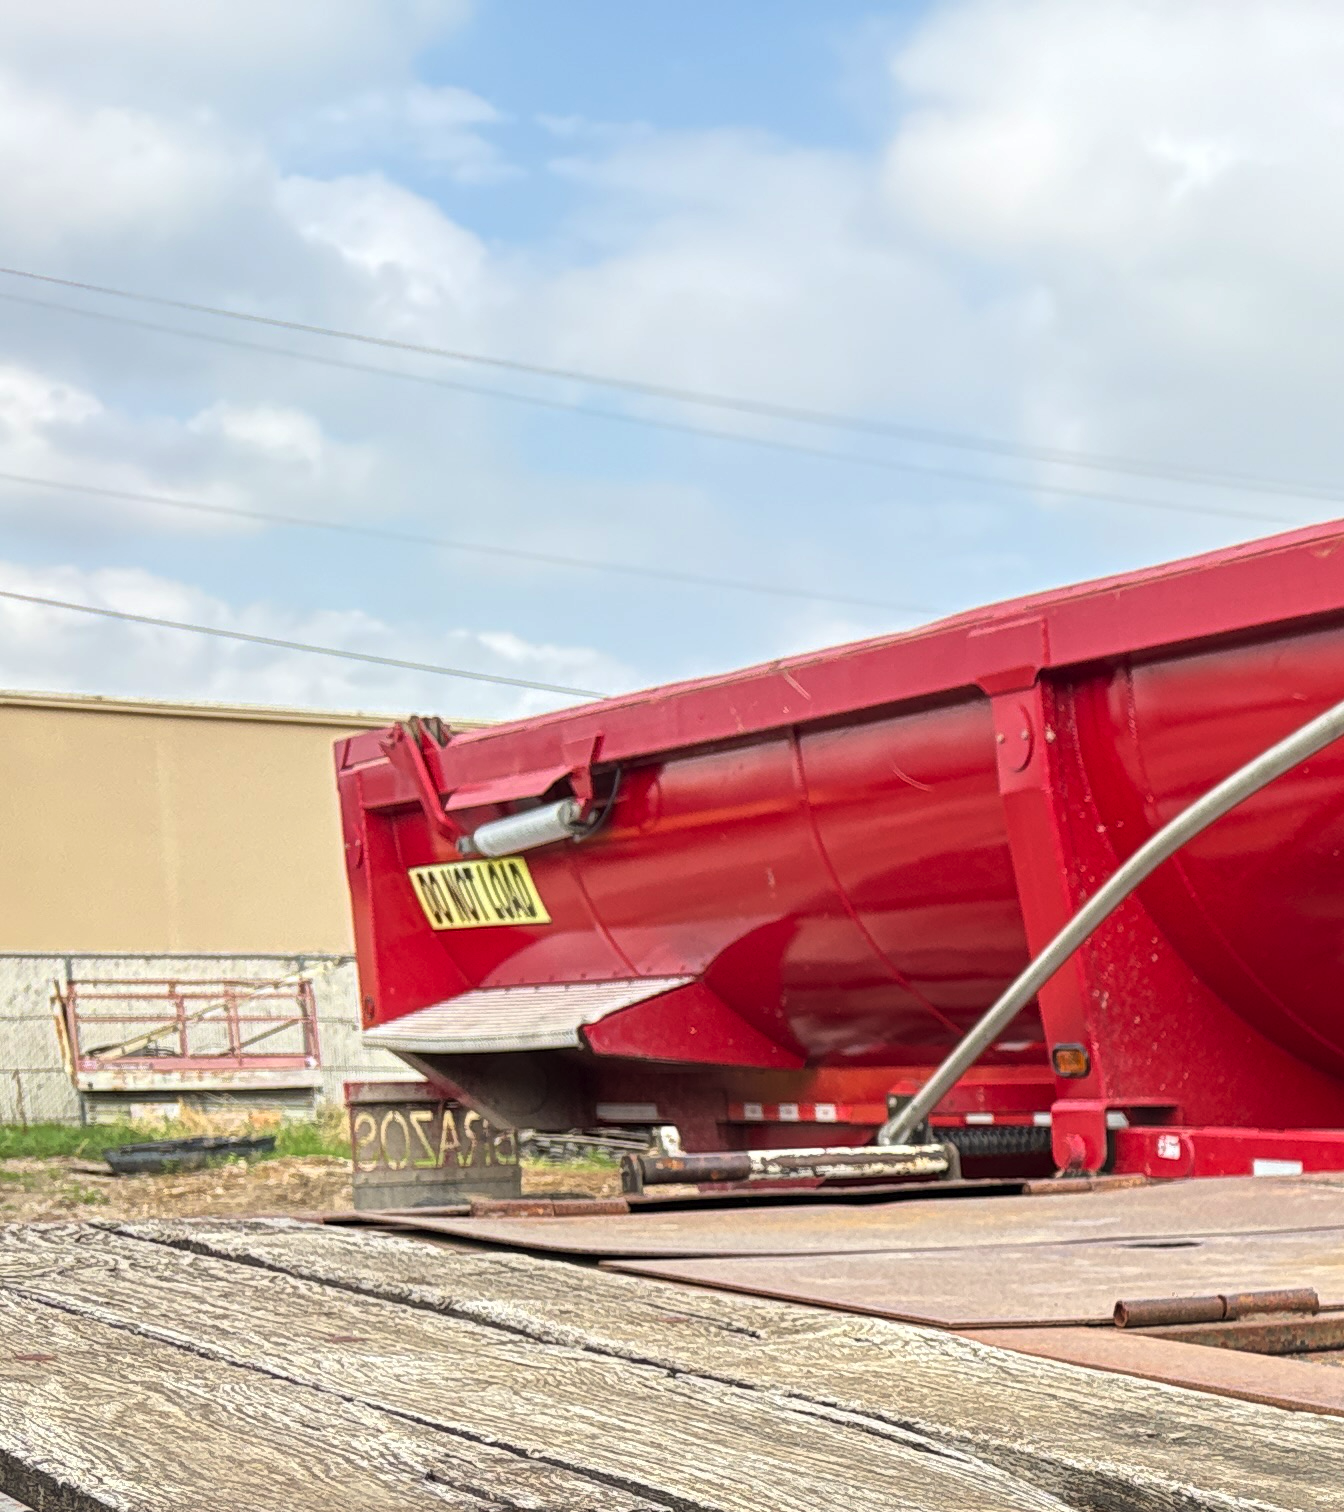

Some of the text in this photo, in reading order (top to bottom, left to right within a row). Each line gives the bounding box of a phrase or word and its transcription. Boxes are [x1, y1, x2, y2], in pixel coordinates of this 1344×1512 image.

[416, 860, 538, 925] DO NOT LOAD
